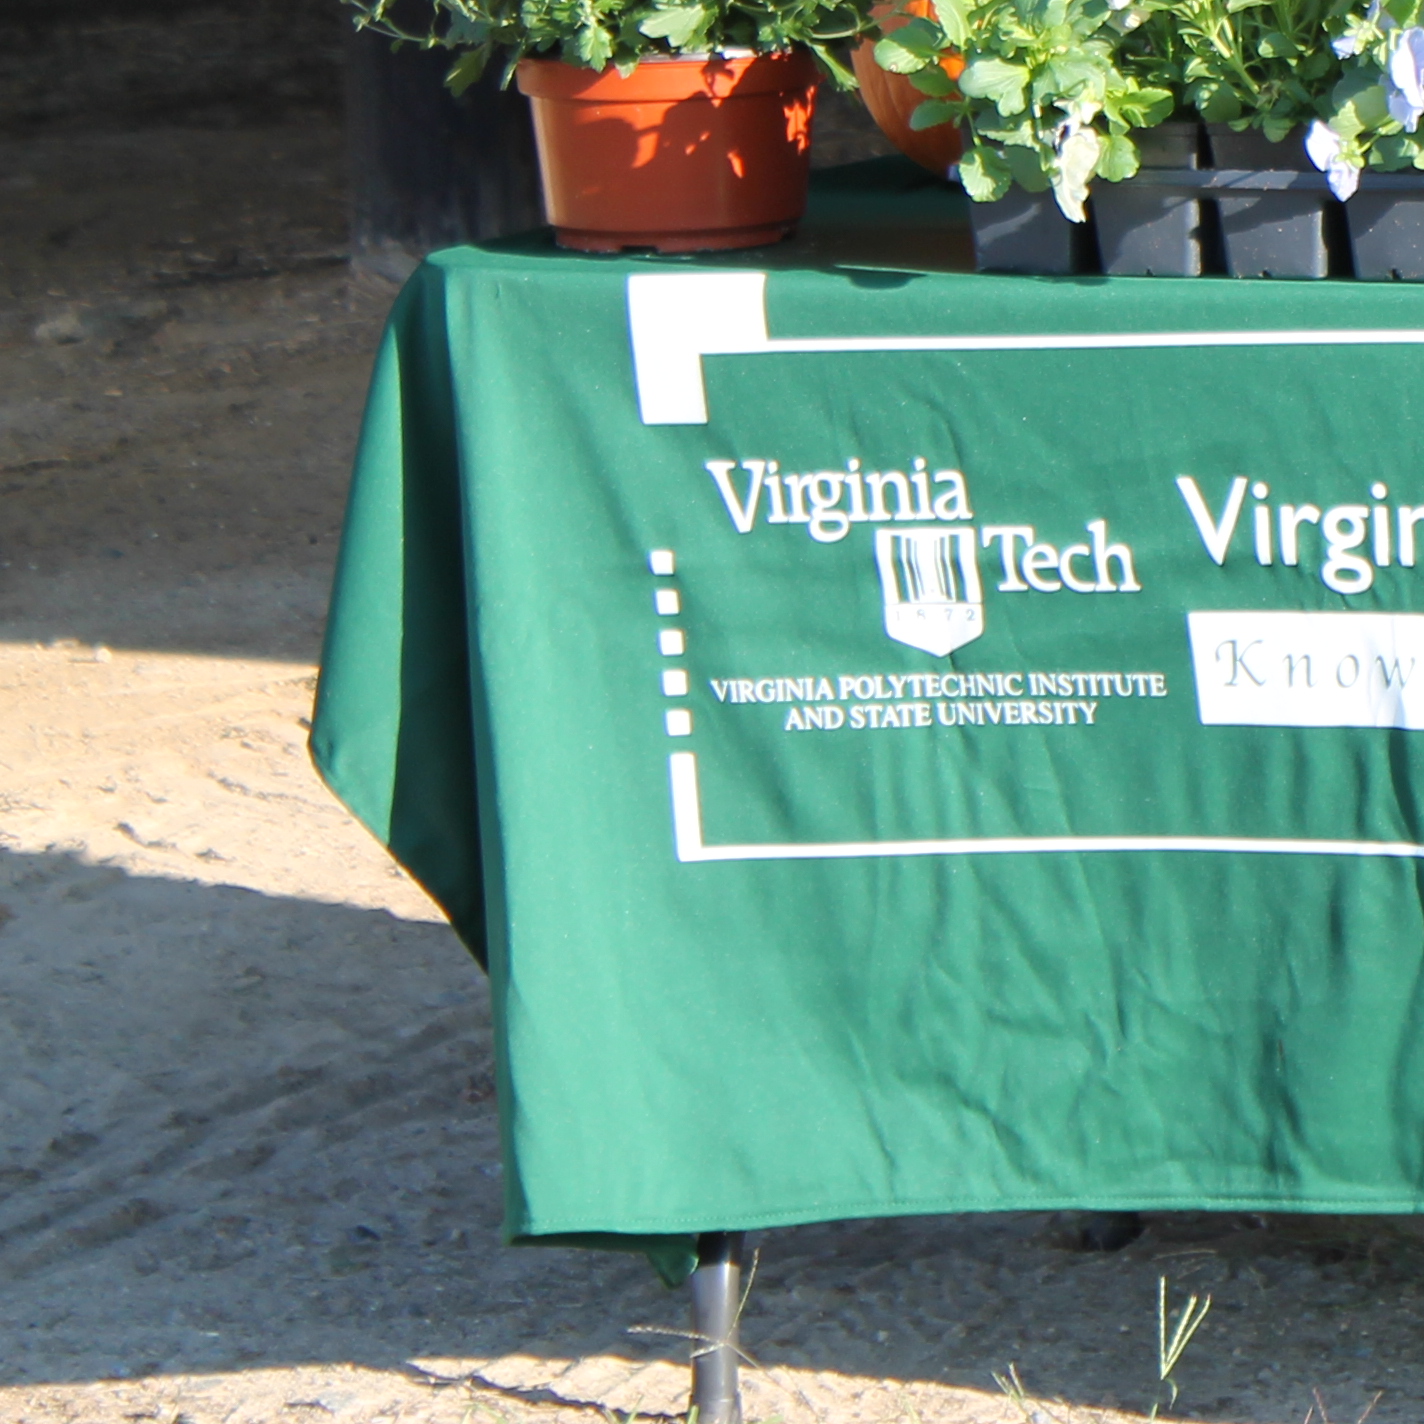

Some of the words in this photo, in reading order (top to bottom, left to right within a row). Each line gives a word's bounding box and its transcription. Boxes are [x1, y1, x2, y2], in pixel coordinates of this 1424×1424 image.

[706, 456, 973, 543] Virginia
[981, 519, 1141, 592] Tech
[710, 677, 833, 704] VIRGINIA
[838, 673, 1022, 700] POLYTECHNIC
[1027, 672, 1168, 697] INSTITUTE
[784, 704, 845, 731] AND
[849, 703, 932, 729] STATE
[936, 699, 1098, 726] UNIVERSITY
